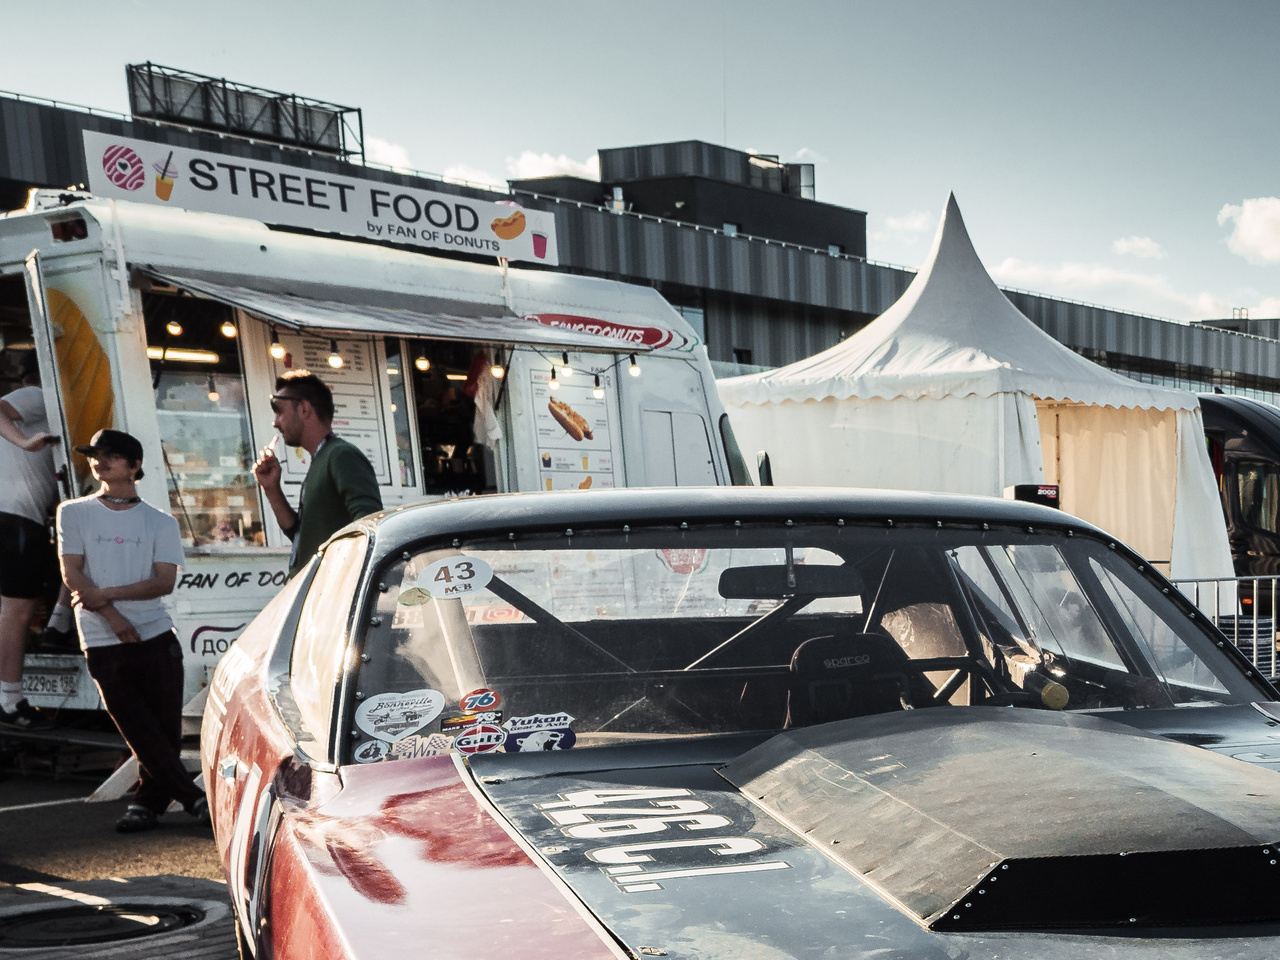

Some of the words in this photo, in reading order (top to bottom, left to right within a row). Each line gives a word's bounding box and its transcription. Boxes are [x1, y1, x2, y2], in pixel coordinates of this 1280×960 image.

[188, 158, 355, 213] STREET
[369, 189, 480, 232] FOOD
[366, 220, 384, 236] by
[387, 224, 418, 240] FAN
[421, 229, 440, 243] OF
[444, 233, 500, 251] DONUTS
[177, 573, 219, 589] FAN
[224, 571, 252, 588] OF
[433, 561, 476, 583] 43
[823, 654, 871, 669] sparco
[369, 697, 433, 713] Bonneville
[466, 692, 496, 709] 76
[510, 715, 568, 727] Yukon
[457, 731, 503, 747] Gulf
[533, 788, 735, 839] 426
